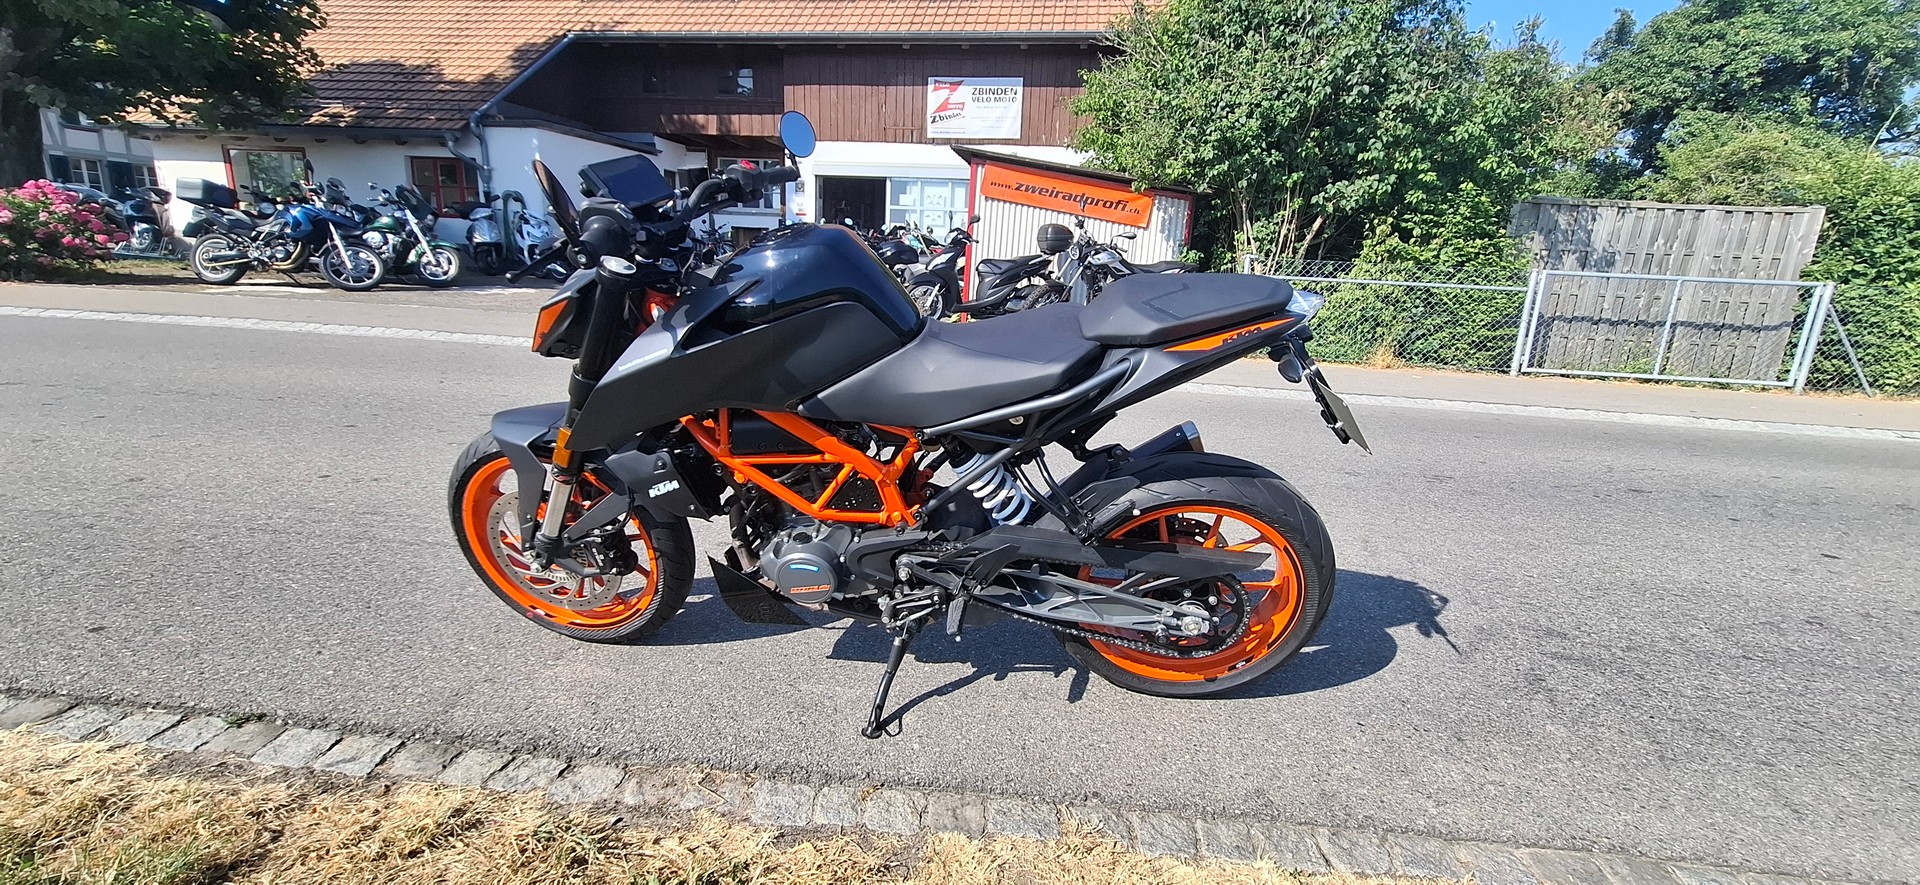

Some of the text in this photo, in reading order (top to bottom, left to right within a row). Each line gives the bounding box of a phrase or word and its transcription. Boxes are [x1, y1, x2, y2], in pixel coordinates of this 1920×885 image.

[971, 87, 1018, 96] ZBINDEN
[990, 181, 1140, 215] www.zweiradprofi.ch
[648, 480, 680, 498] KTM
